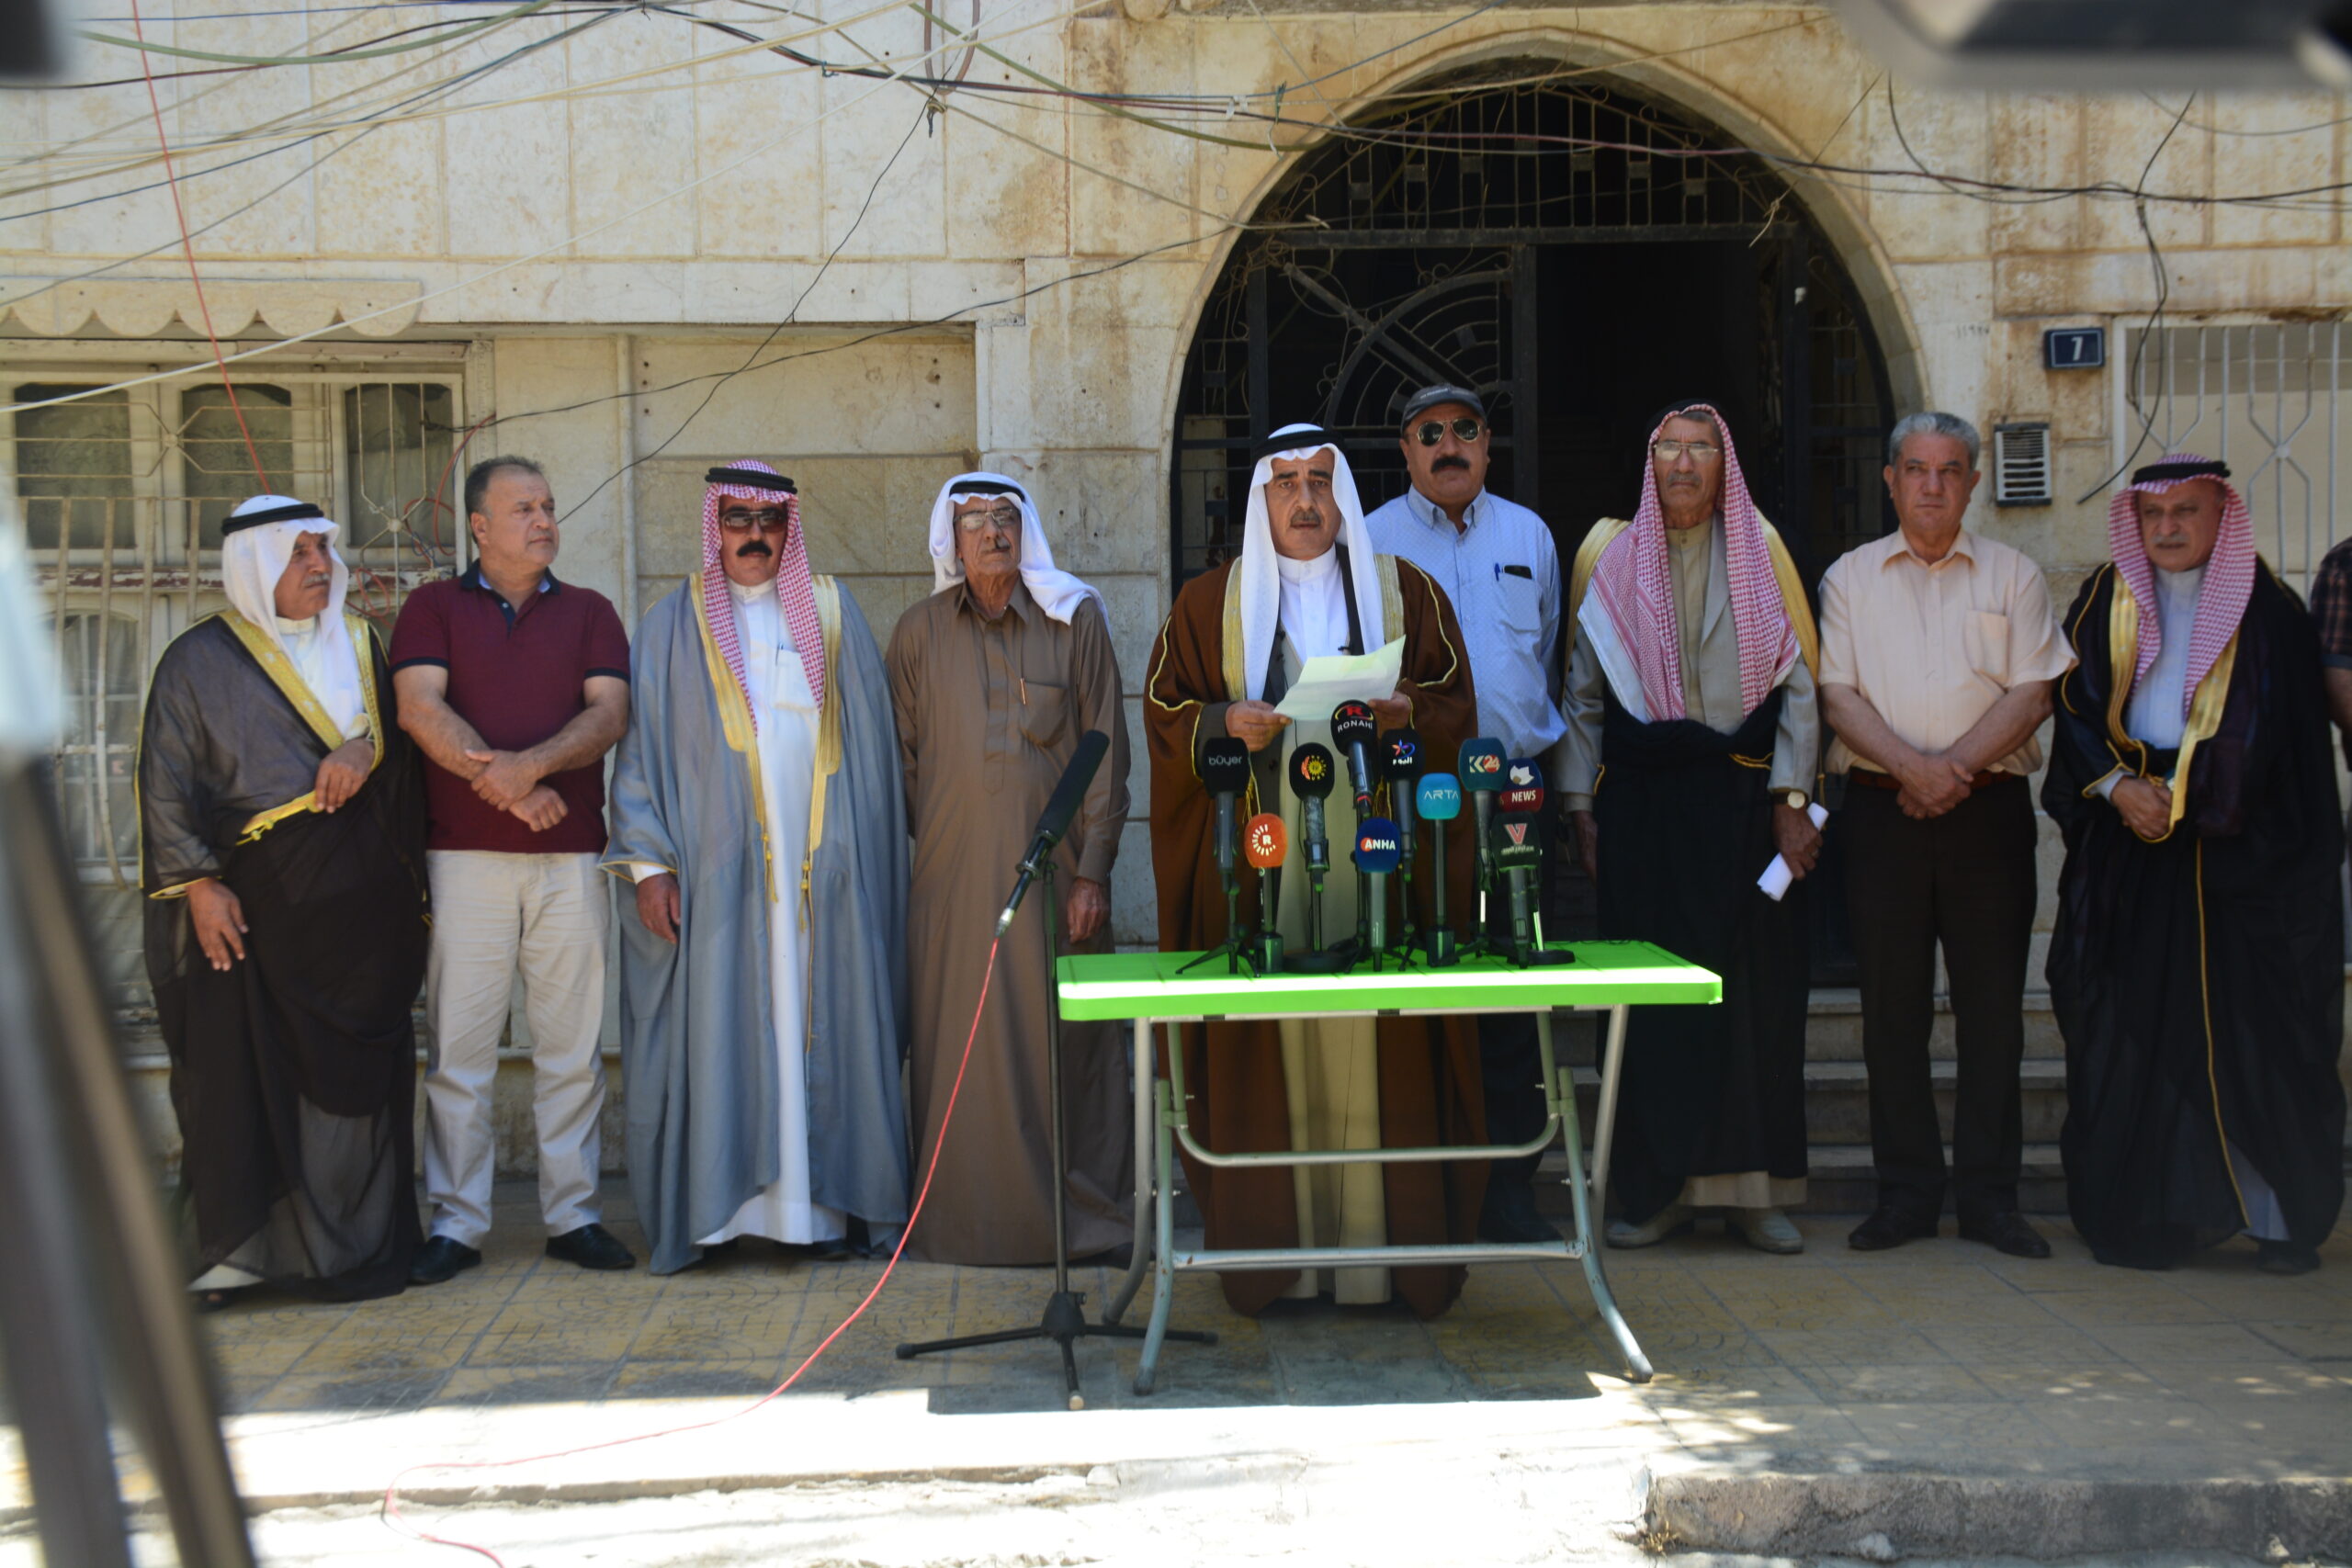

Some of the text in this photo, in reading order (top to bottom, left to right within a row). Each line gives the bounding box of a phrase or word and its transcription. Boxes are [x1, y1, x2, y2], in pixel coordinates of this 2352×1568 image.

[1424, 789, 1459, 800] ARTA
[1511, 789, 1536, 804] NEWS
[1262, 834, 1272, 845] R
[1364, 838, 1396, 851] ANHA
